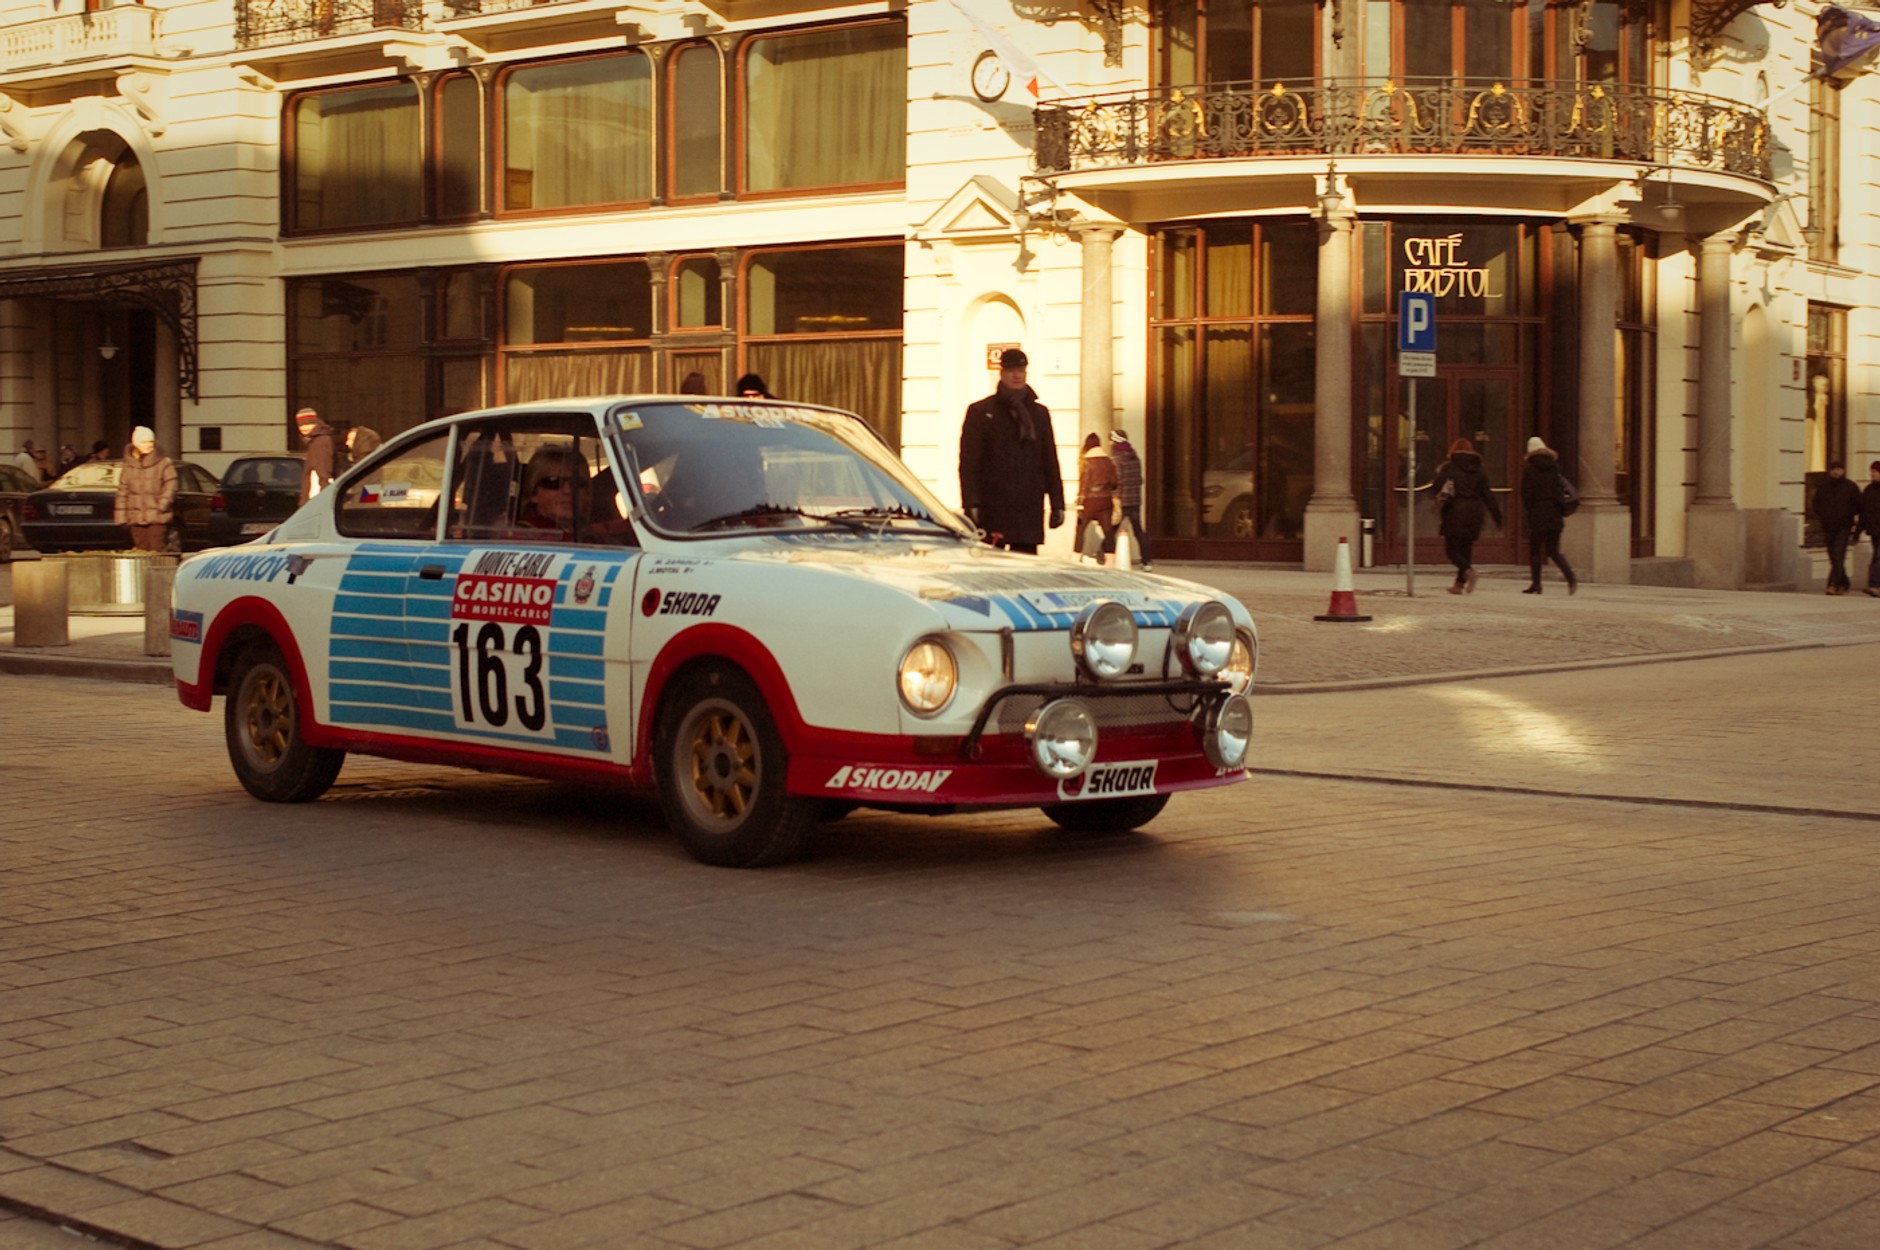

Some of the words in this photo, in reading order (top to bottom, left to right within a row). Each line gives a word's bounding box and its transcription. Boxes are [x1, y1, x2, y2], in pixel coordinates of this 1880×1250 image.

[1404, 233, 1468, 266] CAFÉ
[1404, 268, 1503, 298] BRISTOL
[1408, 298, 1429, 344] P
[194, 554, 291, 583] MOTOKOV
[473, 551, 556, 579] MONTE-CARLO
[457, 580, 553, 606] CASINO
[660, 591, 722, 617] SKODA
[453, 604, 467, 614] DE
[472, 605, 550, 620] MONTE-CARLO
[453, 621, 546, 732] 163
[847, 767, 933, 792] SKODA
[1088, 765, 1155, 794] SKODA
